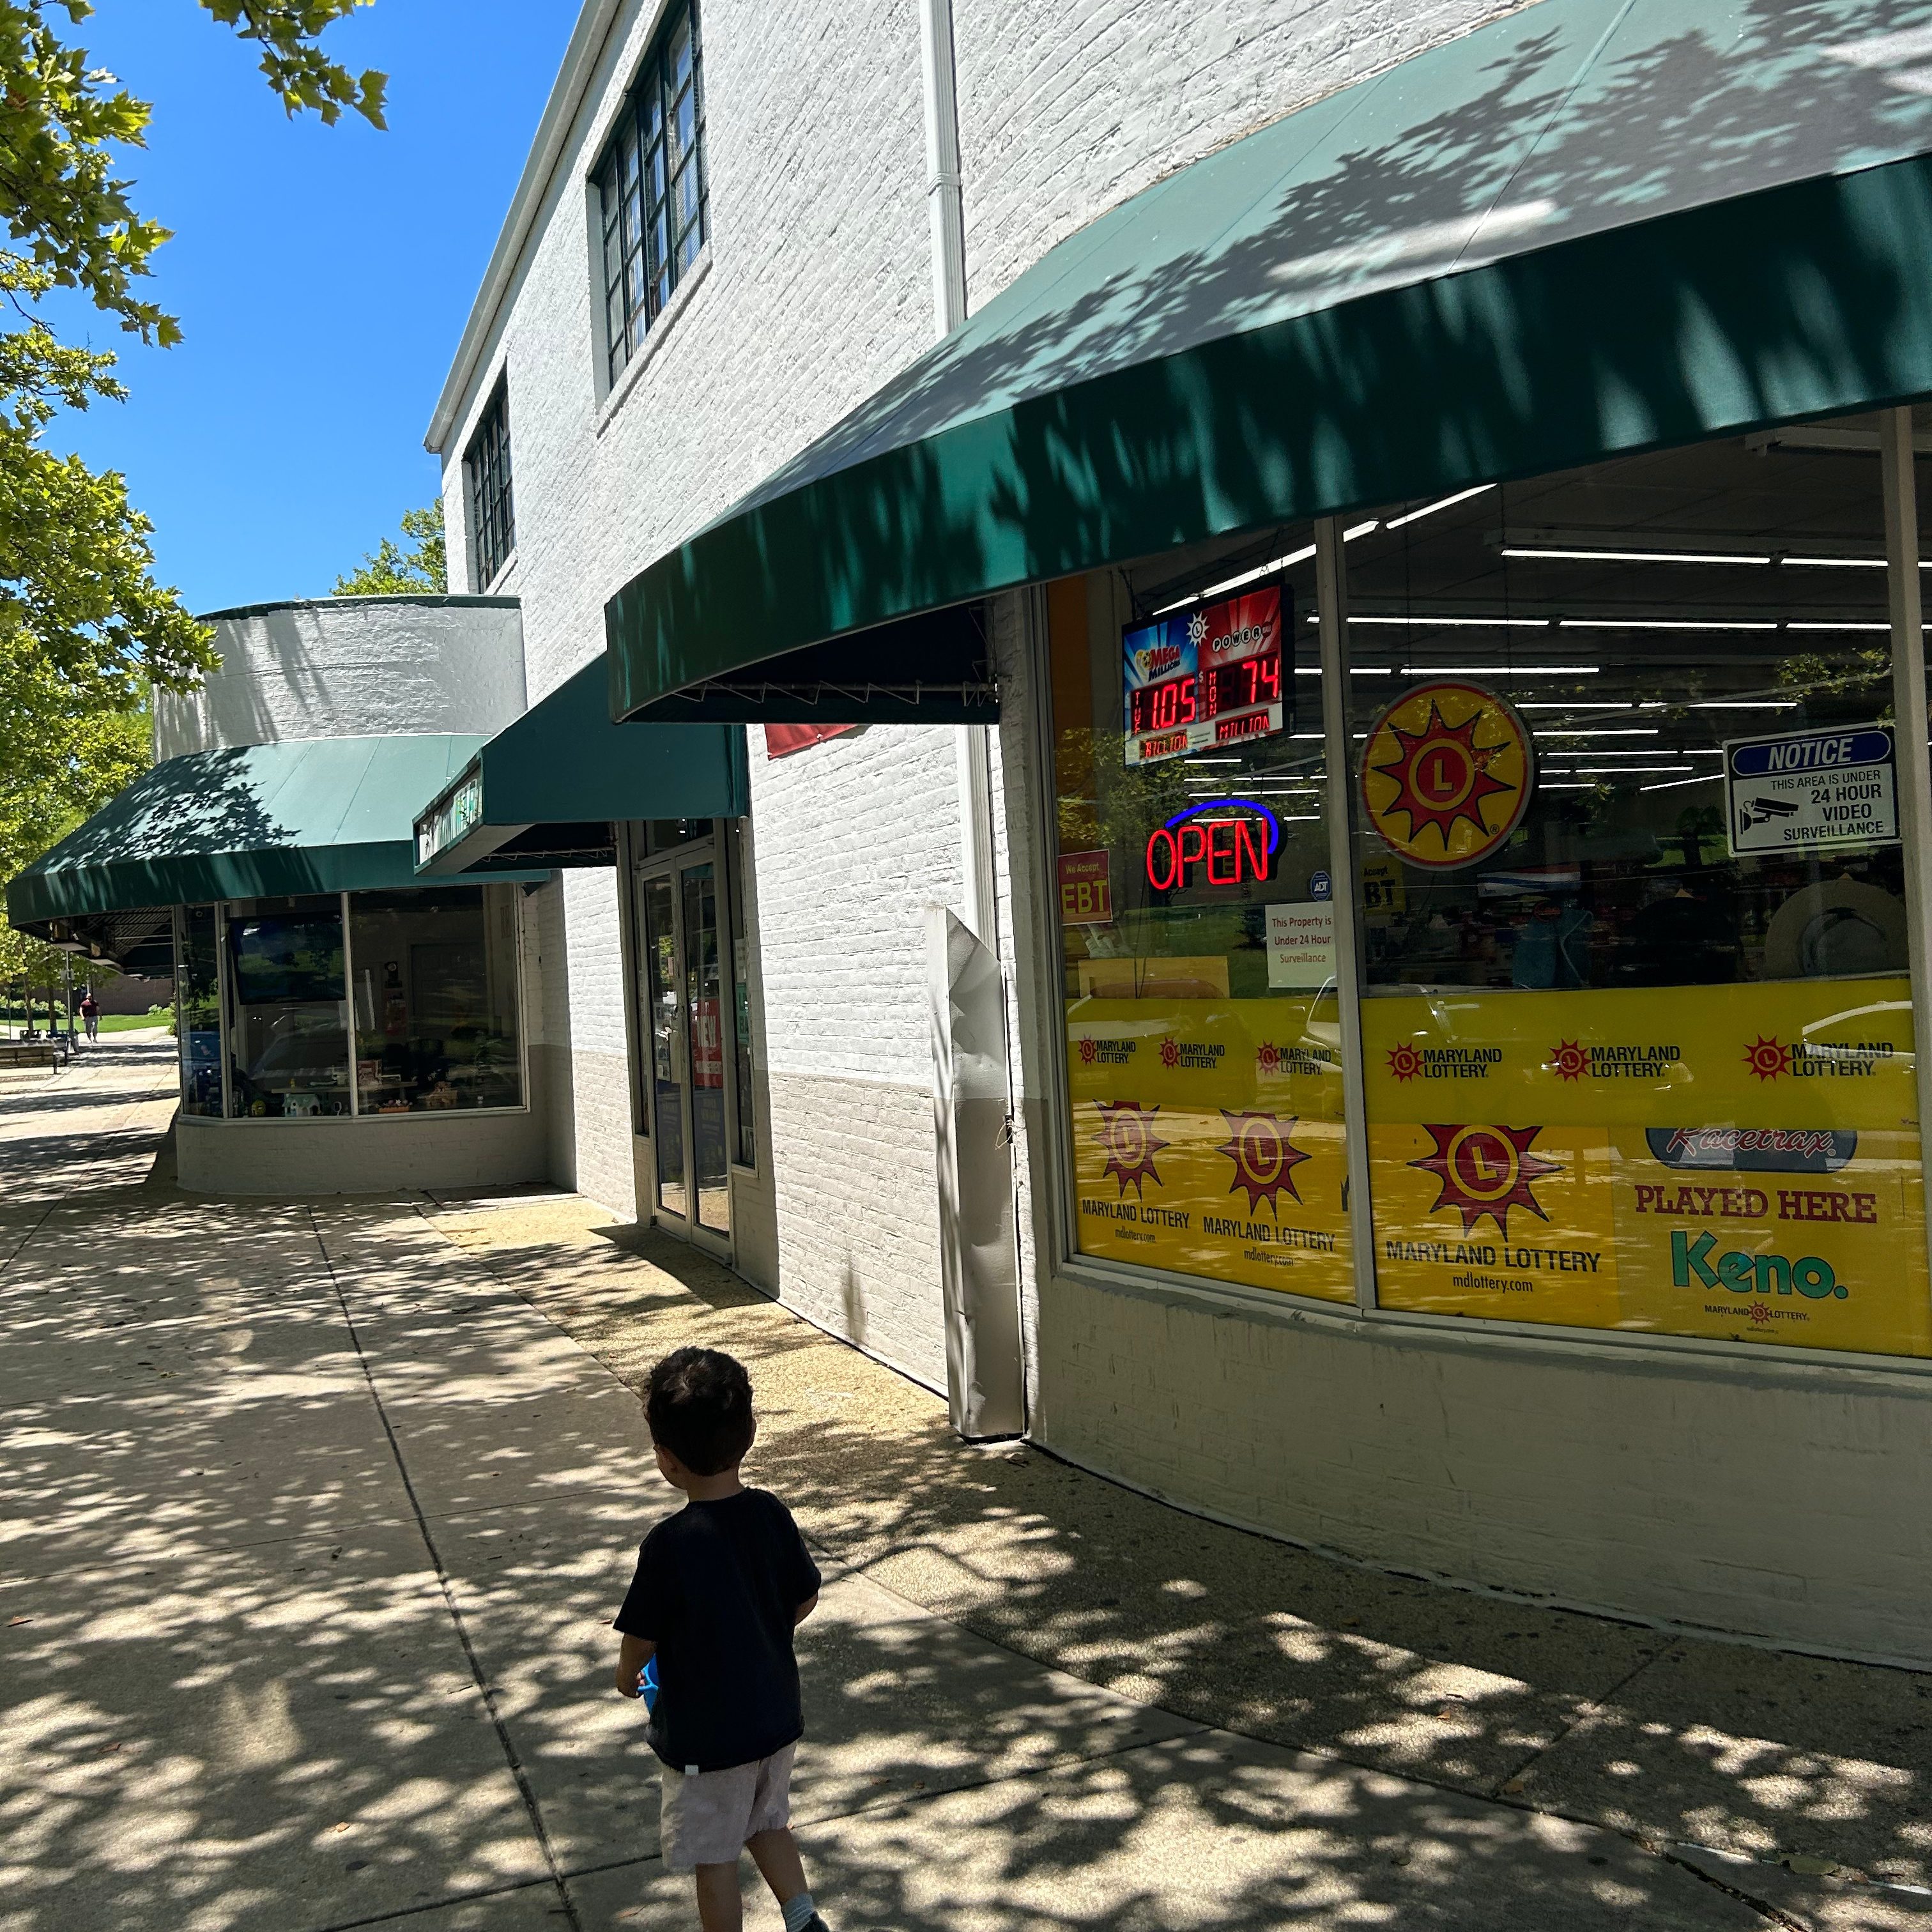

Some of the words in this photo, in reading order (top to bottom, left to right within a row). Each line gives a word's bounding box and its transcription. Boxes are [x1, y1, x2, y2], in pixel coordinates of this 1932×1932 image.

[1149, 645, 1181, 670] MEGA
[1243, 658, 1278, 703] 74
[1220, 716, 1269, 740] MILLION
[1768, 738, 1853, 770] NOTICE
[1770, 778, 1794, 790] THIS
[1797, 776, 1825, 788] AREA
[1829, 774, 1839, 785] IS
[1843, 769, 1880, 783] UNDER
[1811, 788, 1831, 804] 24
[1836, 783, 1882, 801] HOUR
[1822, 803, 1872, 822] VIDEO
[1784, 820, 1883, 841] SURVEILLANCE
[1147, 818, 1268, 889] OPEN
[1065, 864, 1076, 875] We
[1077, 862, 1100, 873] Accept
[1314, 881, 1328, 892] ADT
[1363, 879, 1395, 908] BT
[1061, 878, 1107, 915] EBT
[1272, 917, 1287, 928] This
[1289, 916, 1323, 928] Property
[1324, 915, 1331, 925] is
[1275, 935, 1298, 946] Under
[1300, 935, 1309, 944] 24
[1311, 935, 1331, 944] Hour
[1280, 952, 1326, 963] Surveillance
[1096, 1040, 1136, 1052] MARYLAND
[1179, 1043, 1224, 1056] MARYLAND
[1591, 1046, 1680, 1061] MARYLAND
[1792, 1042, 1894, 1059] MARYLAND
[1097, 1053, 1128, 1064] LOTTERY
[1180, 1055, 1216, 1068] LOTTERY
[1280, 1048, 1331, 1062] MARYLAND
[1424, 1048, 1502, 1063] MARYLAND
[1280, 1061, 1321, 1075] LOTTERY
[1424, 1063, 1487, 1078] LOTTERY
[1592, 1061, 1663, 1078] LOTTERY
[1793, 1060, 1874, 1077] LOTTERY
[1666, 1128, 1834, 1159] Racetrax
[1634, 1184, 1768, 1218] PLAYED
[1777, 1190, 1878, 1224] HERE
[1082, 1199, 1137, 1222] MARYLAND
[1140, 1206, 1190, 1229] LOTTERY
[1115, 1226, 1156, 1243] mdlottery.com
[1203, 1216, 1271, 1242] MARYLAND
[1275, 1226, 1335, 1252] LOTTERY
[1244, 1246, 1294, 1266] mdlottery.com
[1386, 1241, 1496, 1266] MARYLAND
[1505, 1247, 1601, 1273] LOTTERY
[1453, 1272, 1533, 1294] mdlottery.com
[1705, 1305, 1750, 1316] MARYLAND
[1770, 1310, 1807, 1321] LOTTERY
